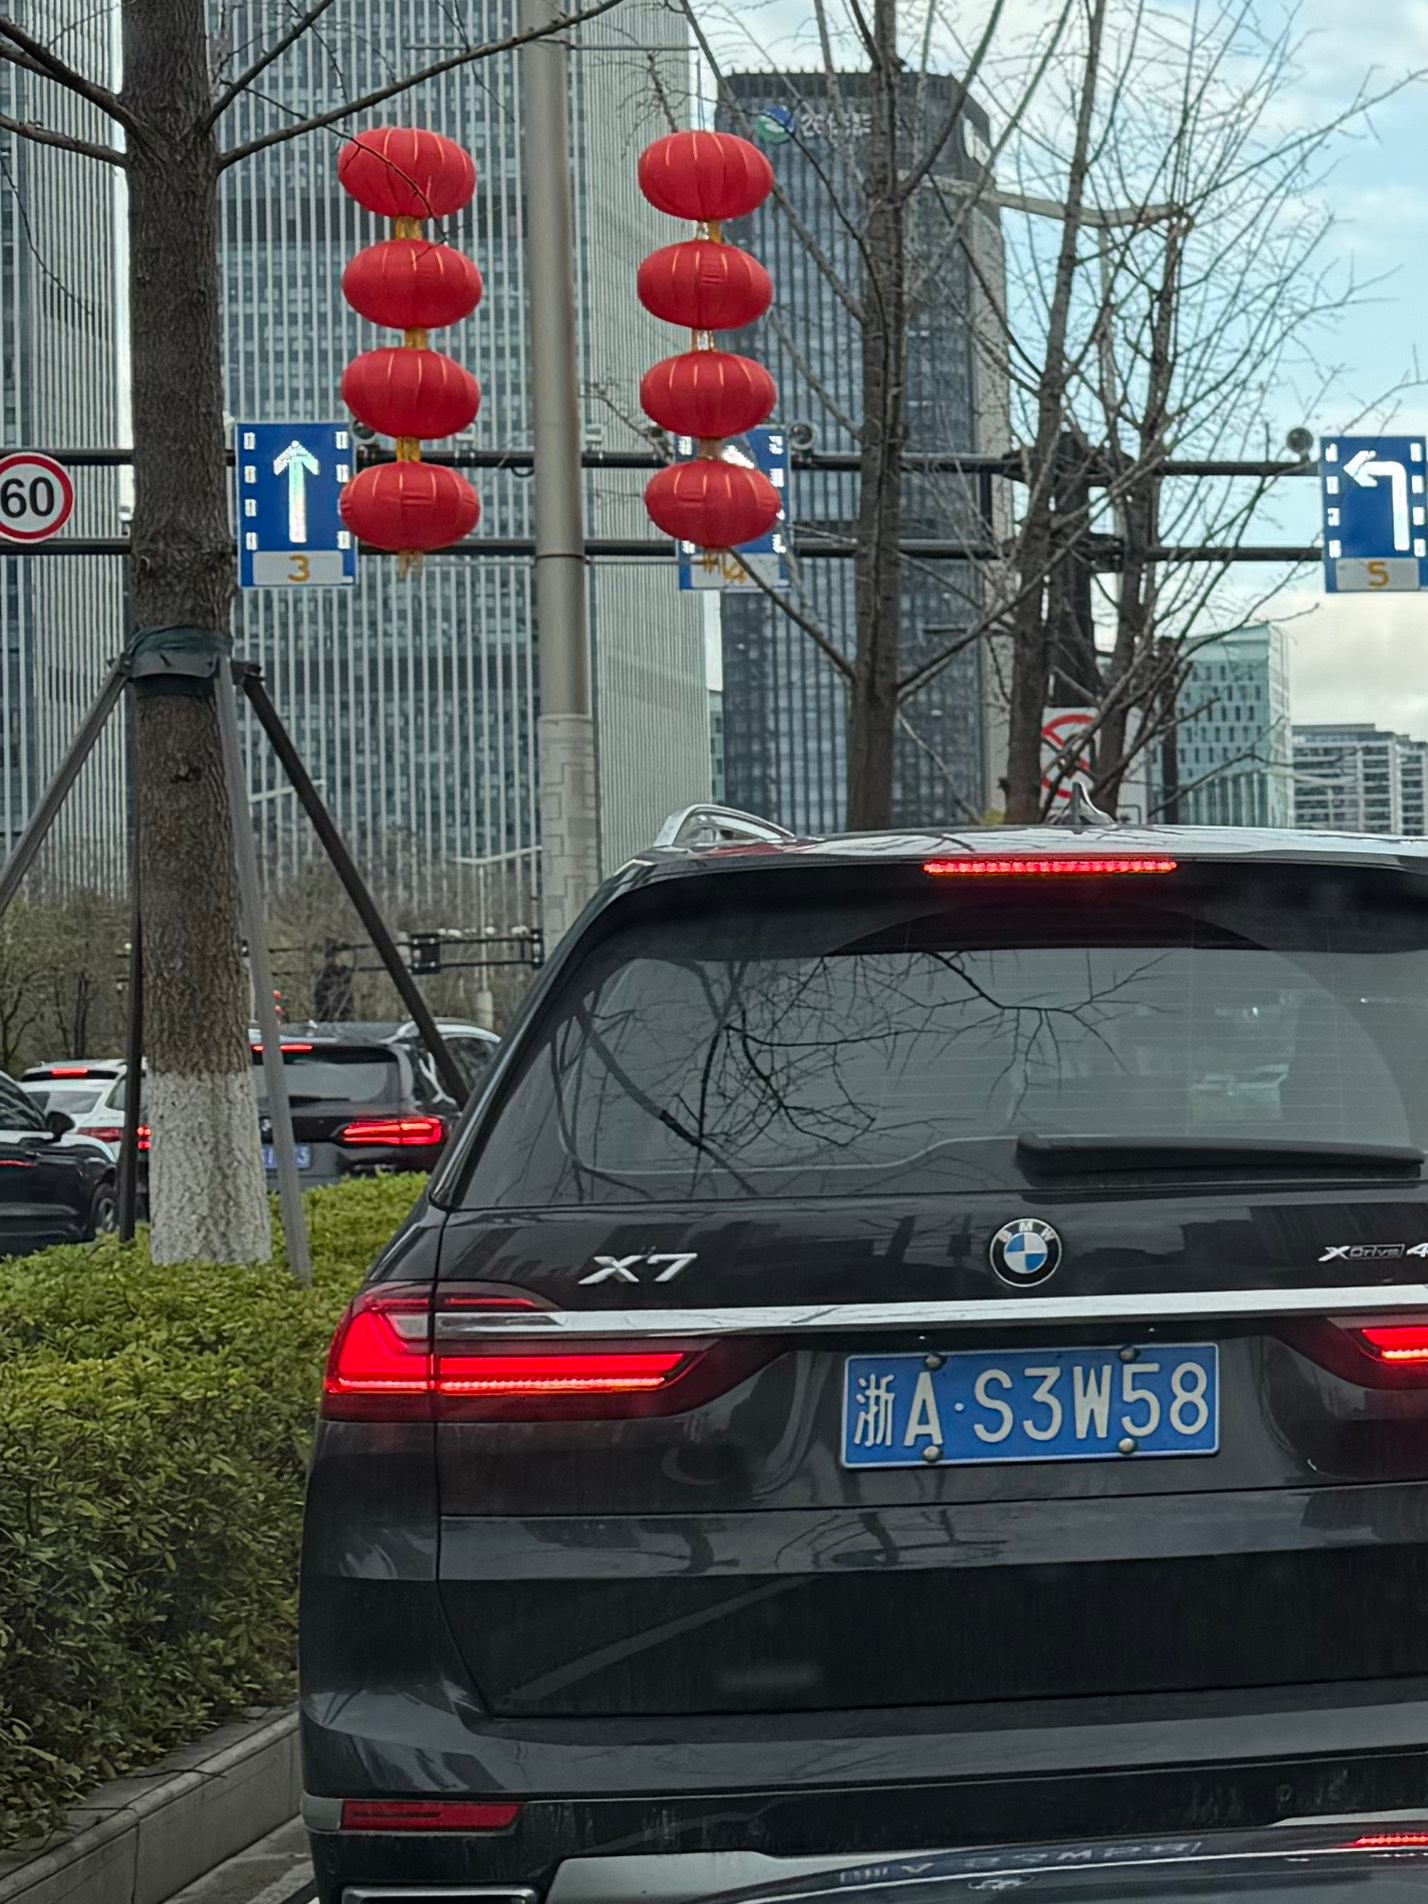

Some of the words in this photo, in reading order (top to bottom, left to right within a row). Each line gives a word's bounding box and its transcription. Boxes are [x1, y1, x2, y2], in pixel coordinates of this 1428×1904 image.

[0, 476, 55, 519] 60
[287, 553, 311, 583] 3
[1366, 560, 1390, 588] 5
[577, 1251, 699, 1285] X7
